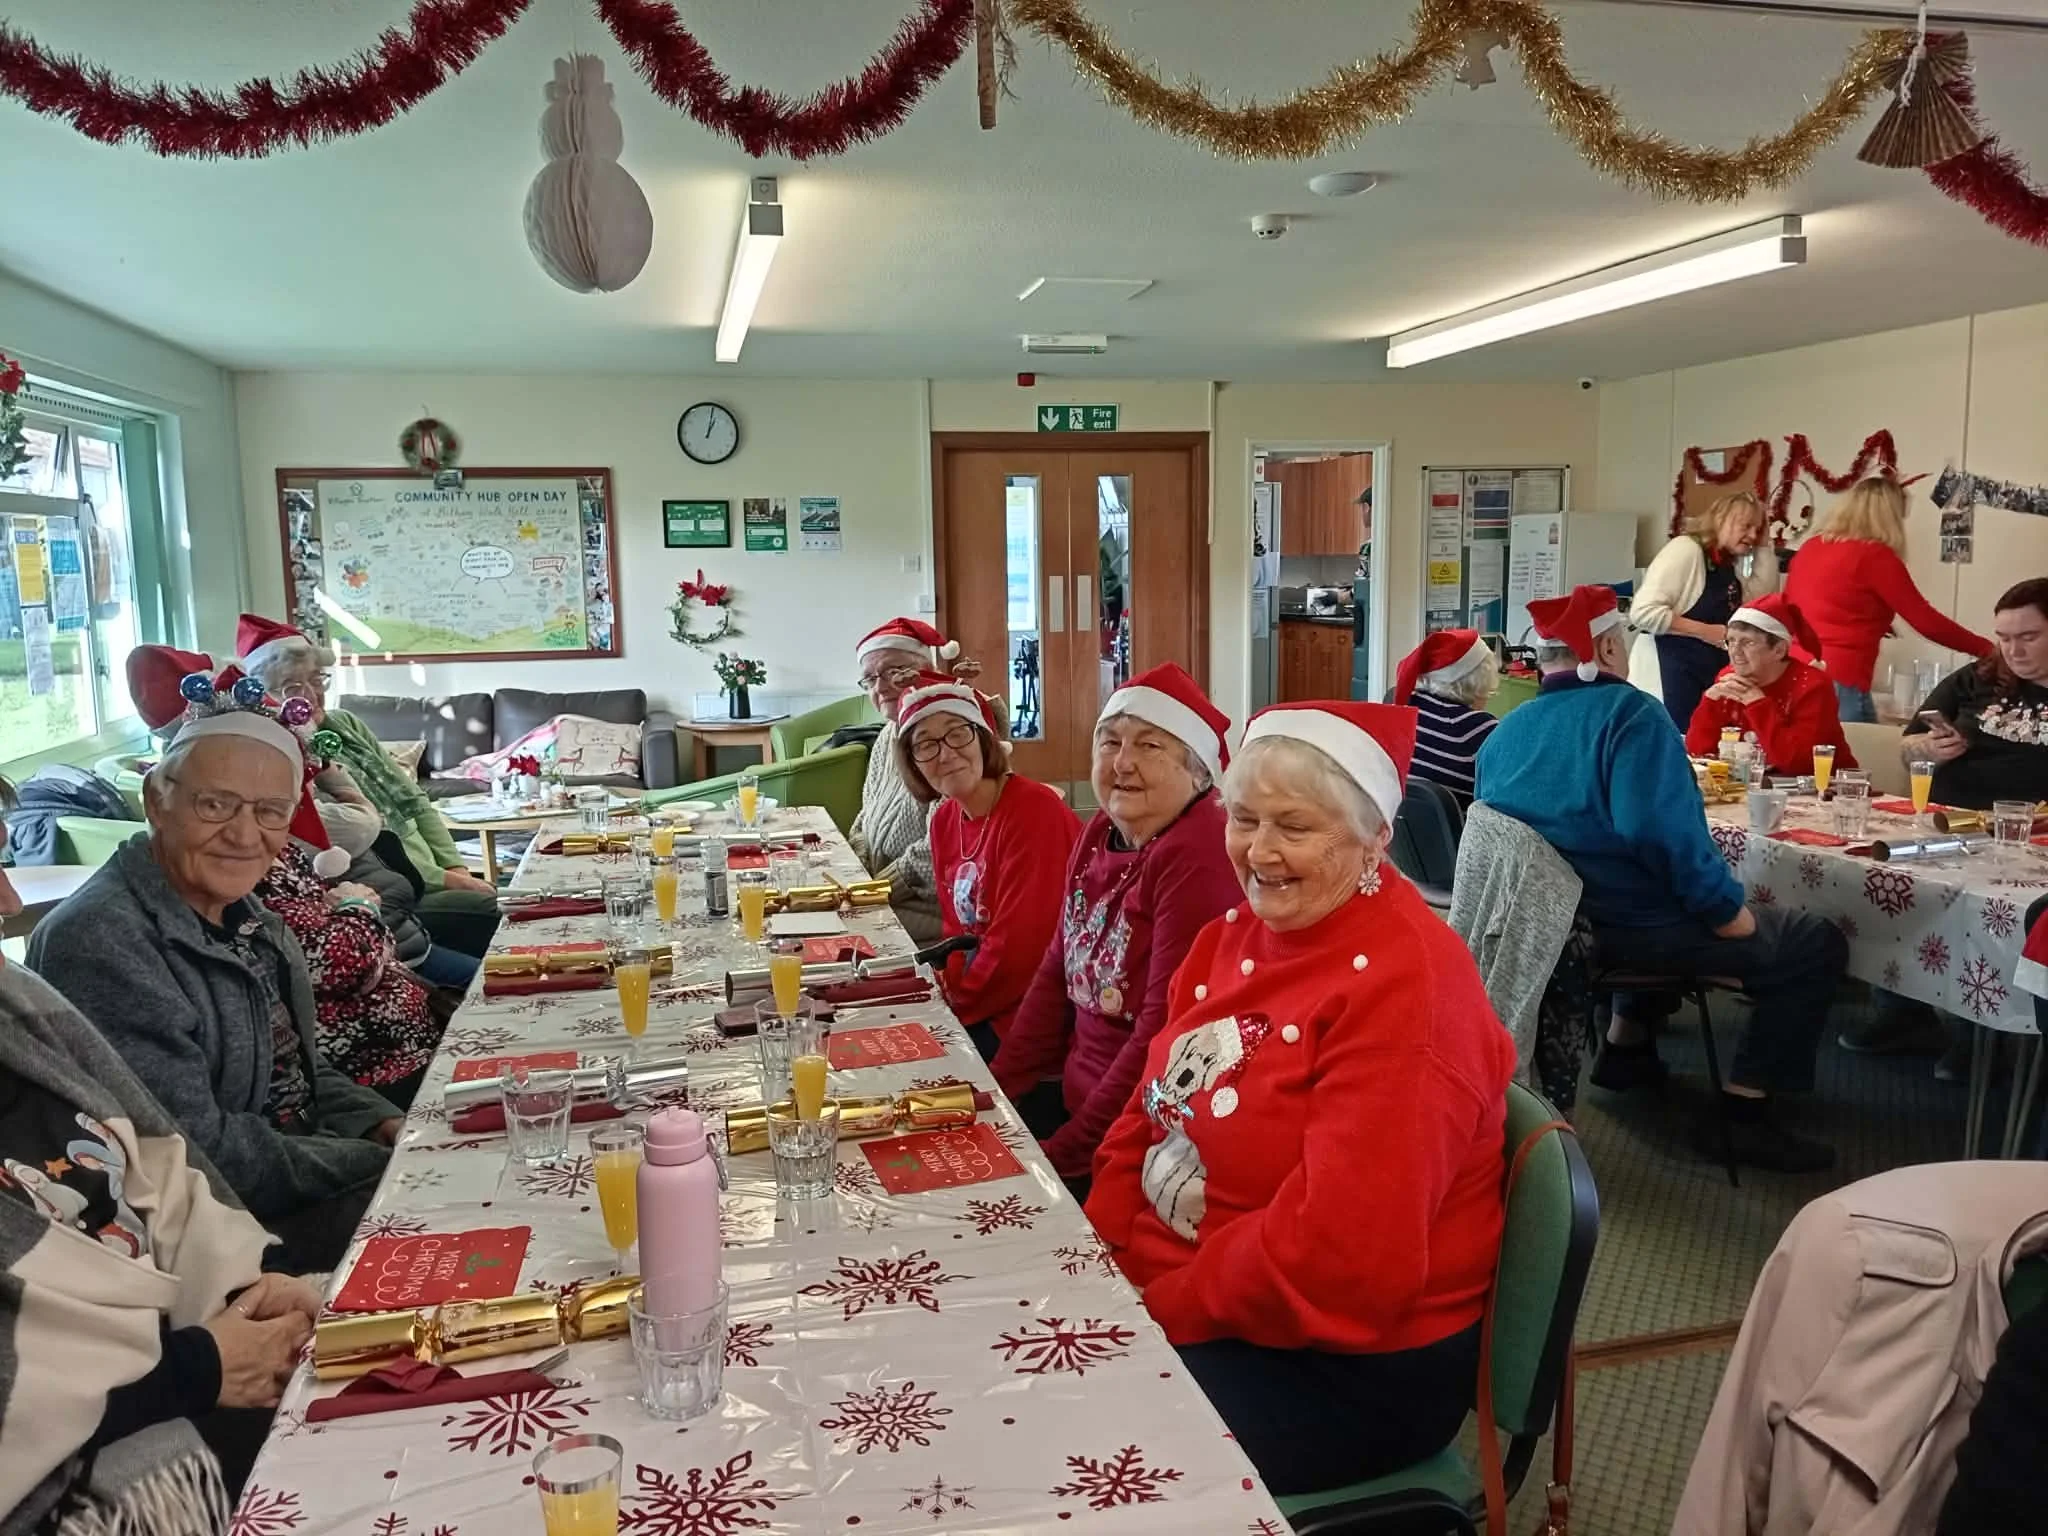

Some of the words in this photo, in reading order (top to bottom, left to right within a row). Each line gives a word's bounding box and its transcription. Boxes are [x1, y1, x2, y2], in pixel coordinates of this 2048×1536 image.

[1092, 408, 1112, 418] Fire
[1093, 419, 1111, 429] exit
[394, 491, 473, 503] COMMUNITY
[477, 491, 500, 502] HUB
[508, 491, 540, 502] OPEN
[544, 491, 567, 501] DAY
[914, 1149, 948, 1173] MERRY
[930, 1135, 975, 1179] CHRISTMAS
[397, 1239, 442, 1300] CHRISTMAS
[431, 1250, 462, 1281] MERRY
